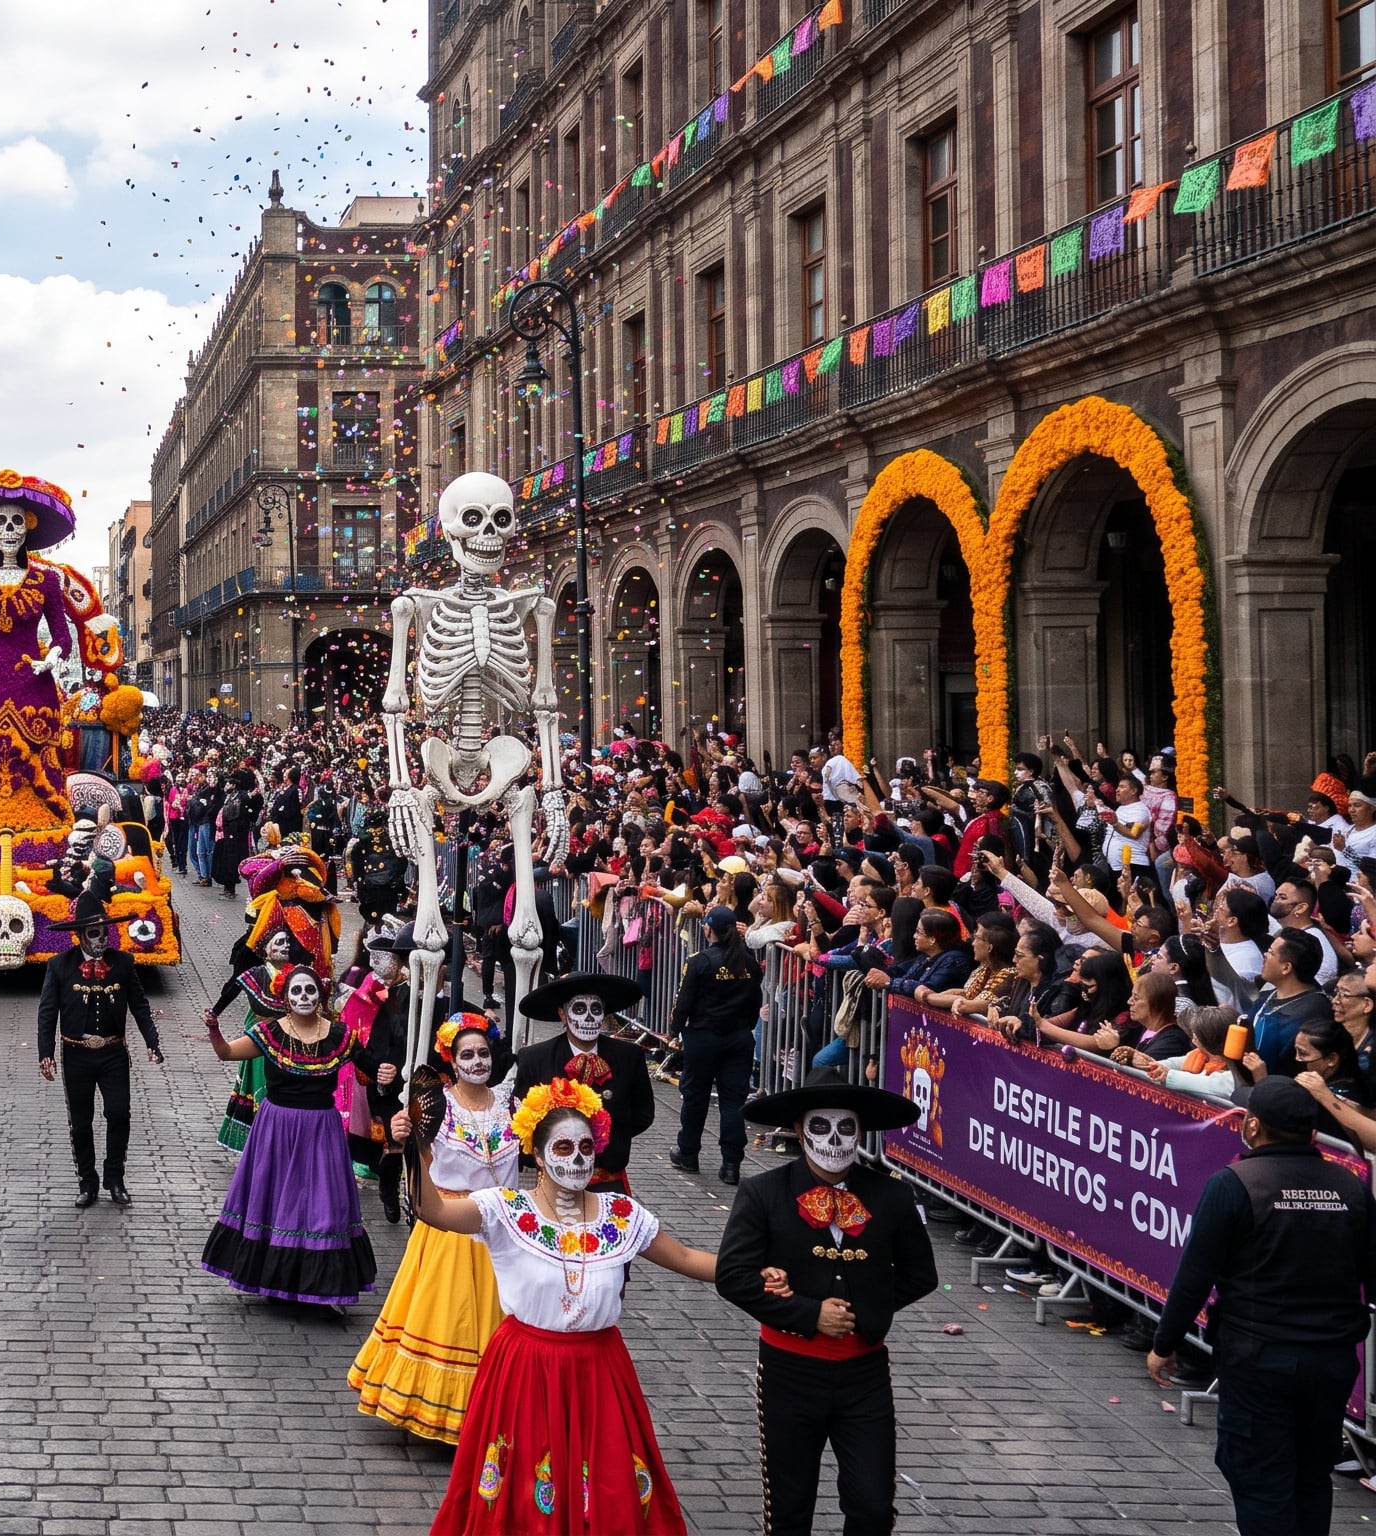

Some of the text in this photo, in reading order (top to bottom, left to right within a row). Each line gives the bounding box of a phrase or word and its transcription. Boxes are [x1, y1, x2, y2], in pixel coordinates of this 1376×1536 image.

[968, 1117, 995, 1160] DE
[1000, 1131, 1107, 1213] MUERTOS
[1113, 1198, 1124, 1211] -
[993, 1076, 1178, 1187] DESFILE DE DÍA
